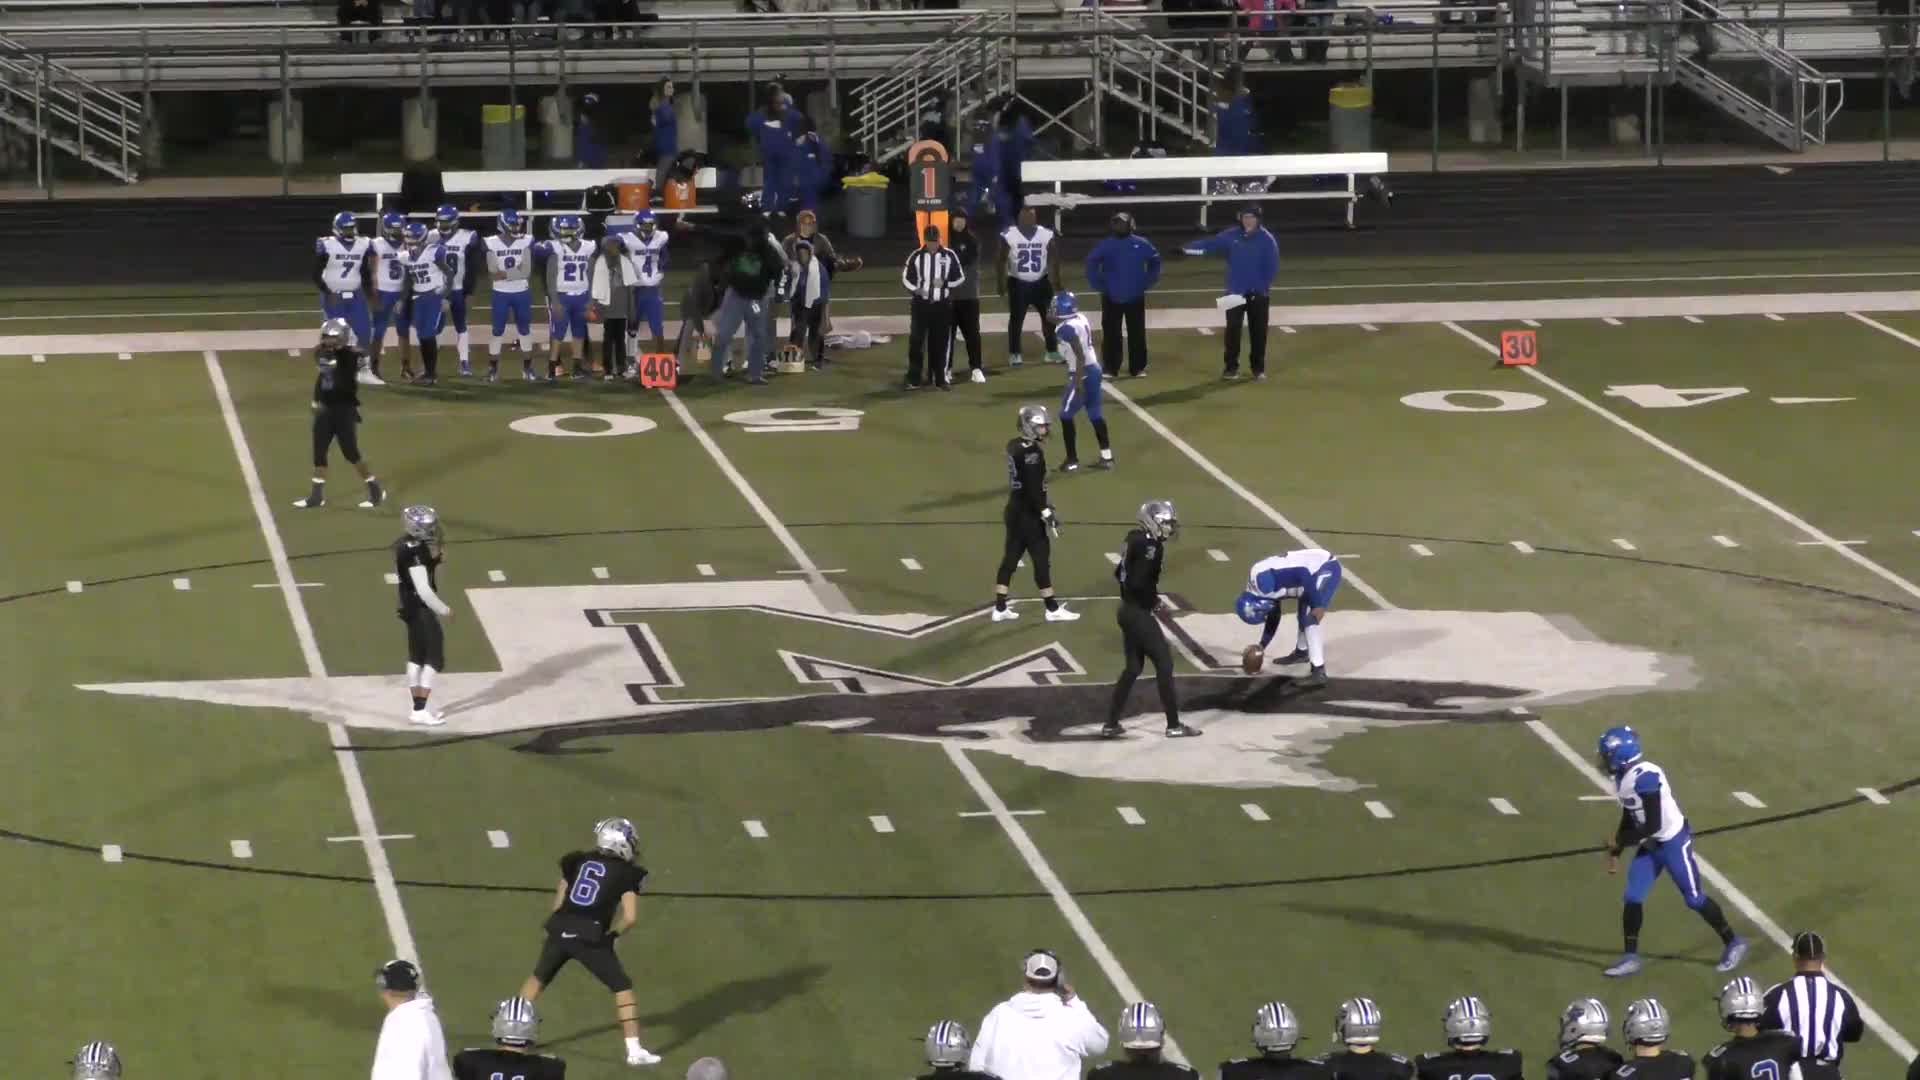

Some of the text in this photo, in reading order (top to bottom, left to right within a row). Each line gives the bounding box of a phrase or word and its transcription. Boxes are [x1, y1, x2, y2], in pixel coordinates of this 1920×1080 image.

[921, 168, 935, 198] 1
[340, 261, 355, 278] 7
[564, 262, 588, 281] 21
[1017, 250, 1041, 272] 25
[1505, 335, 1534, 359] 30
[643, 356, 674, 381] 40
[570, 860, 606, 906] 6
